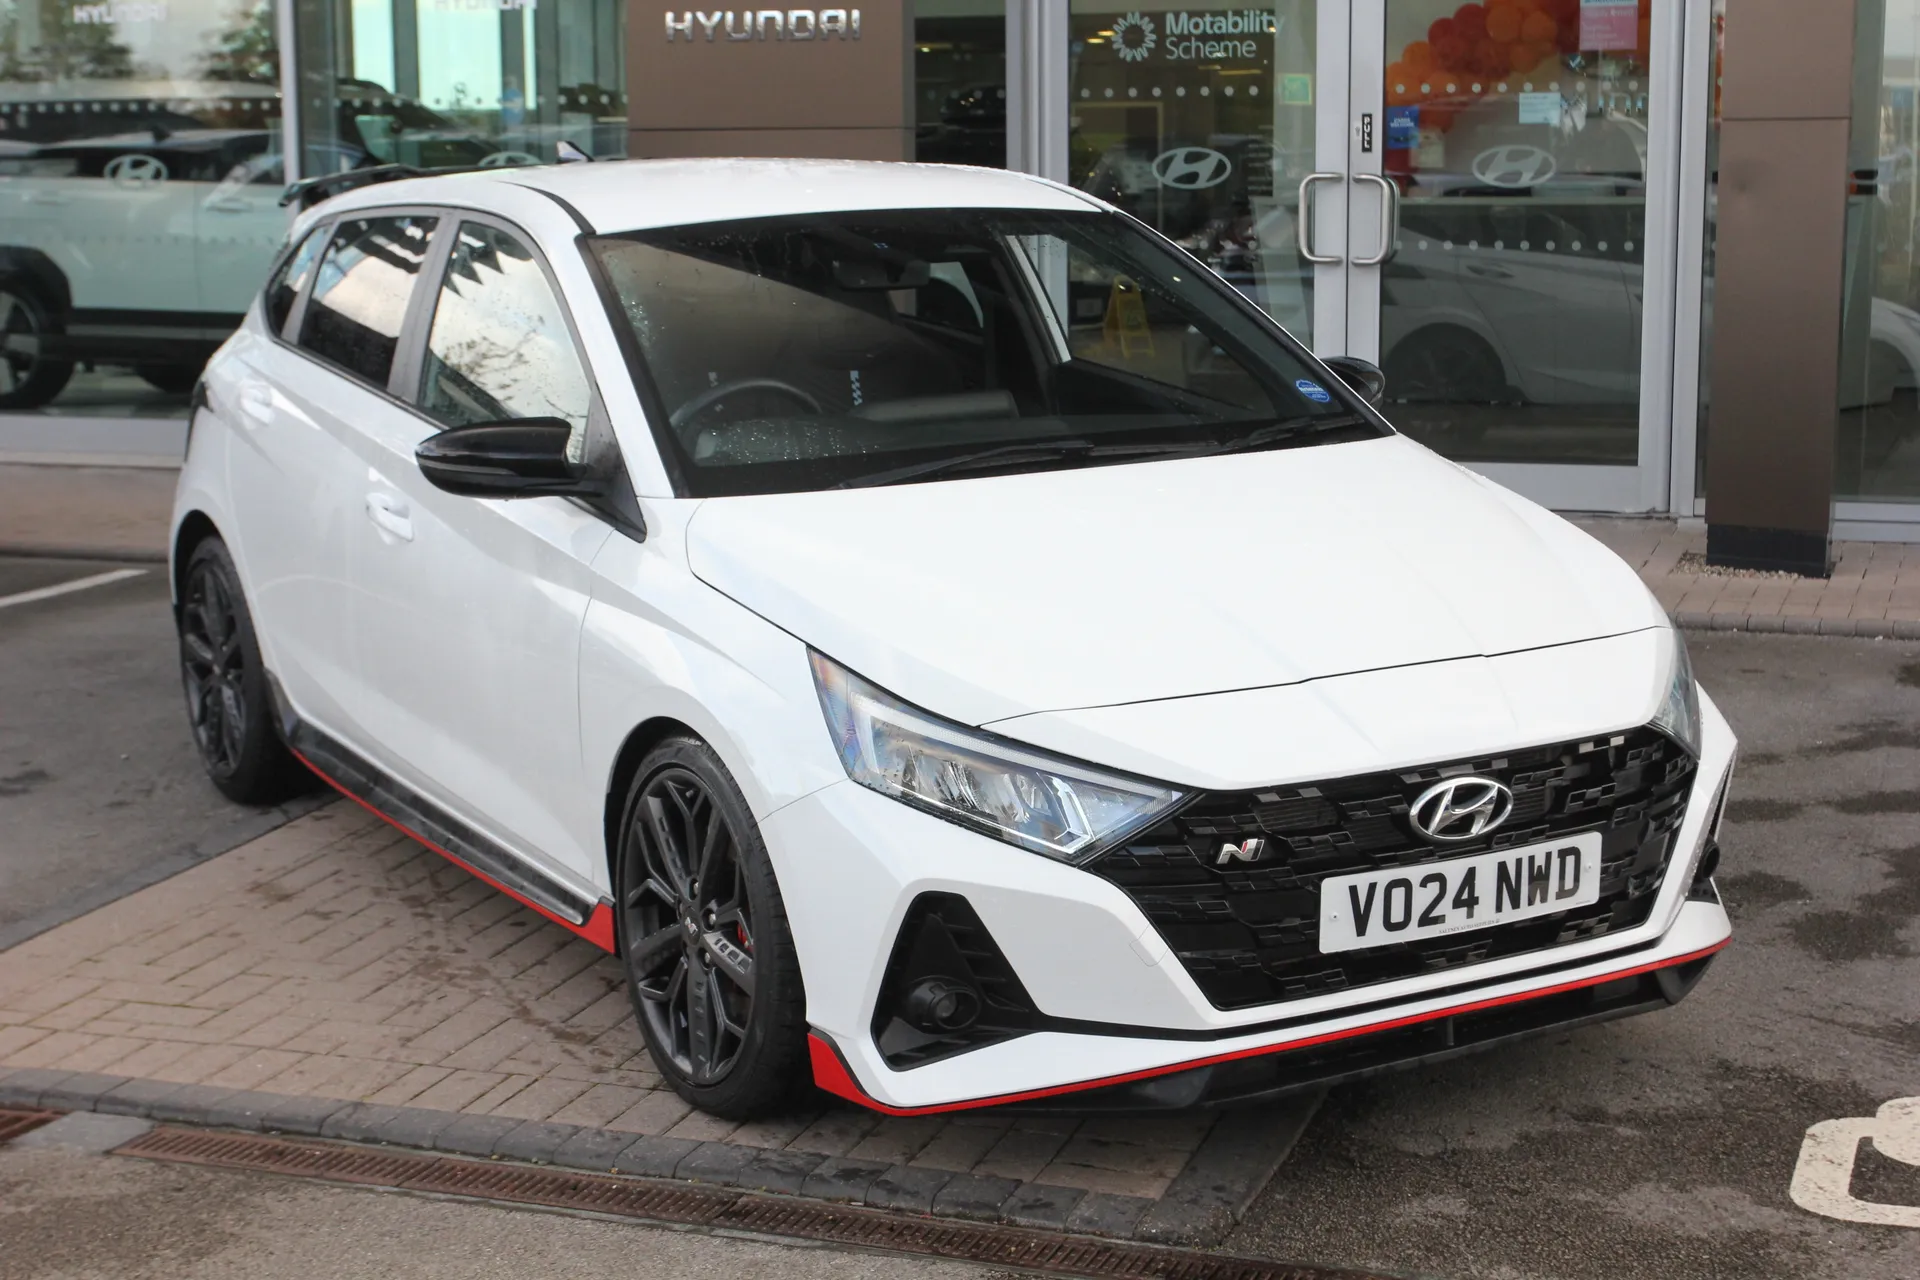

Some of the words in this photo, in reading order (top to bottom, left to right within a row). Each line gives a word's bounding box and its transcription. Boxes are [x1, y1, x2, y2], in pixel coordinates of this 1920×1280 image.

[664, 8, 862, 43] HYUNDAI
[1165, 9, 1286, 37] Motability
[1165, 36, 1257, 60] Scheme
[1363, 115, 1371, 149] PULL
[1348, 866, 1480, 938] VO24
[1495, 846, 1582, 914] NWD
